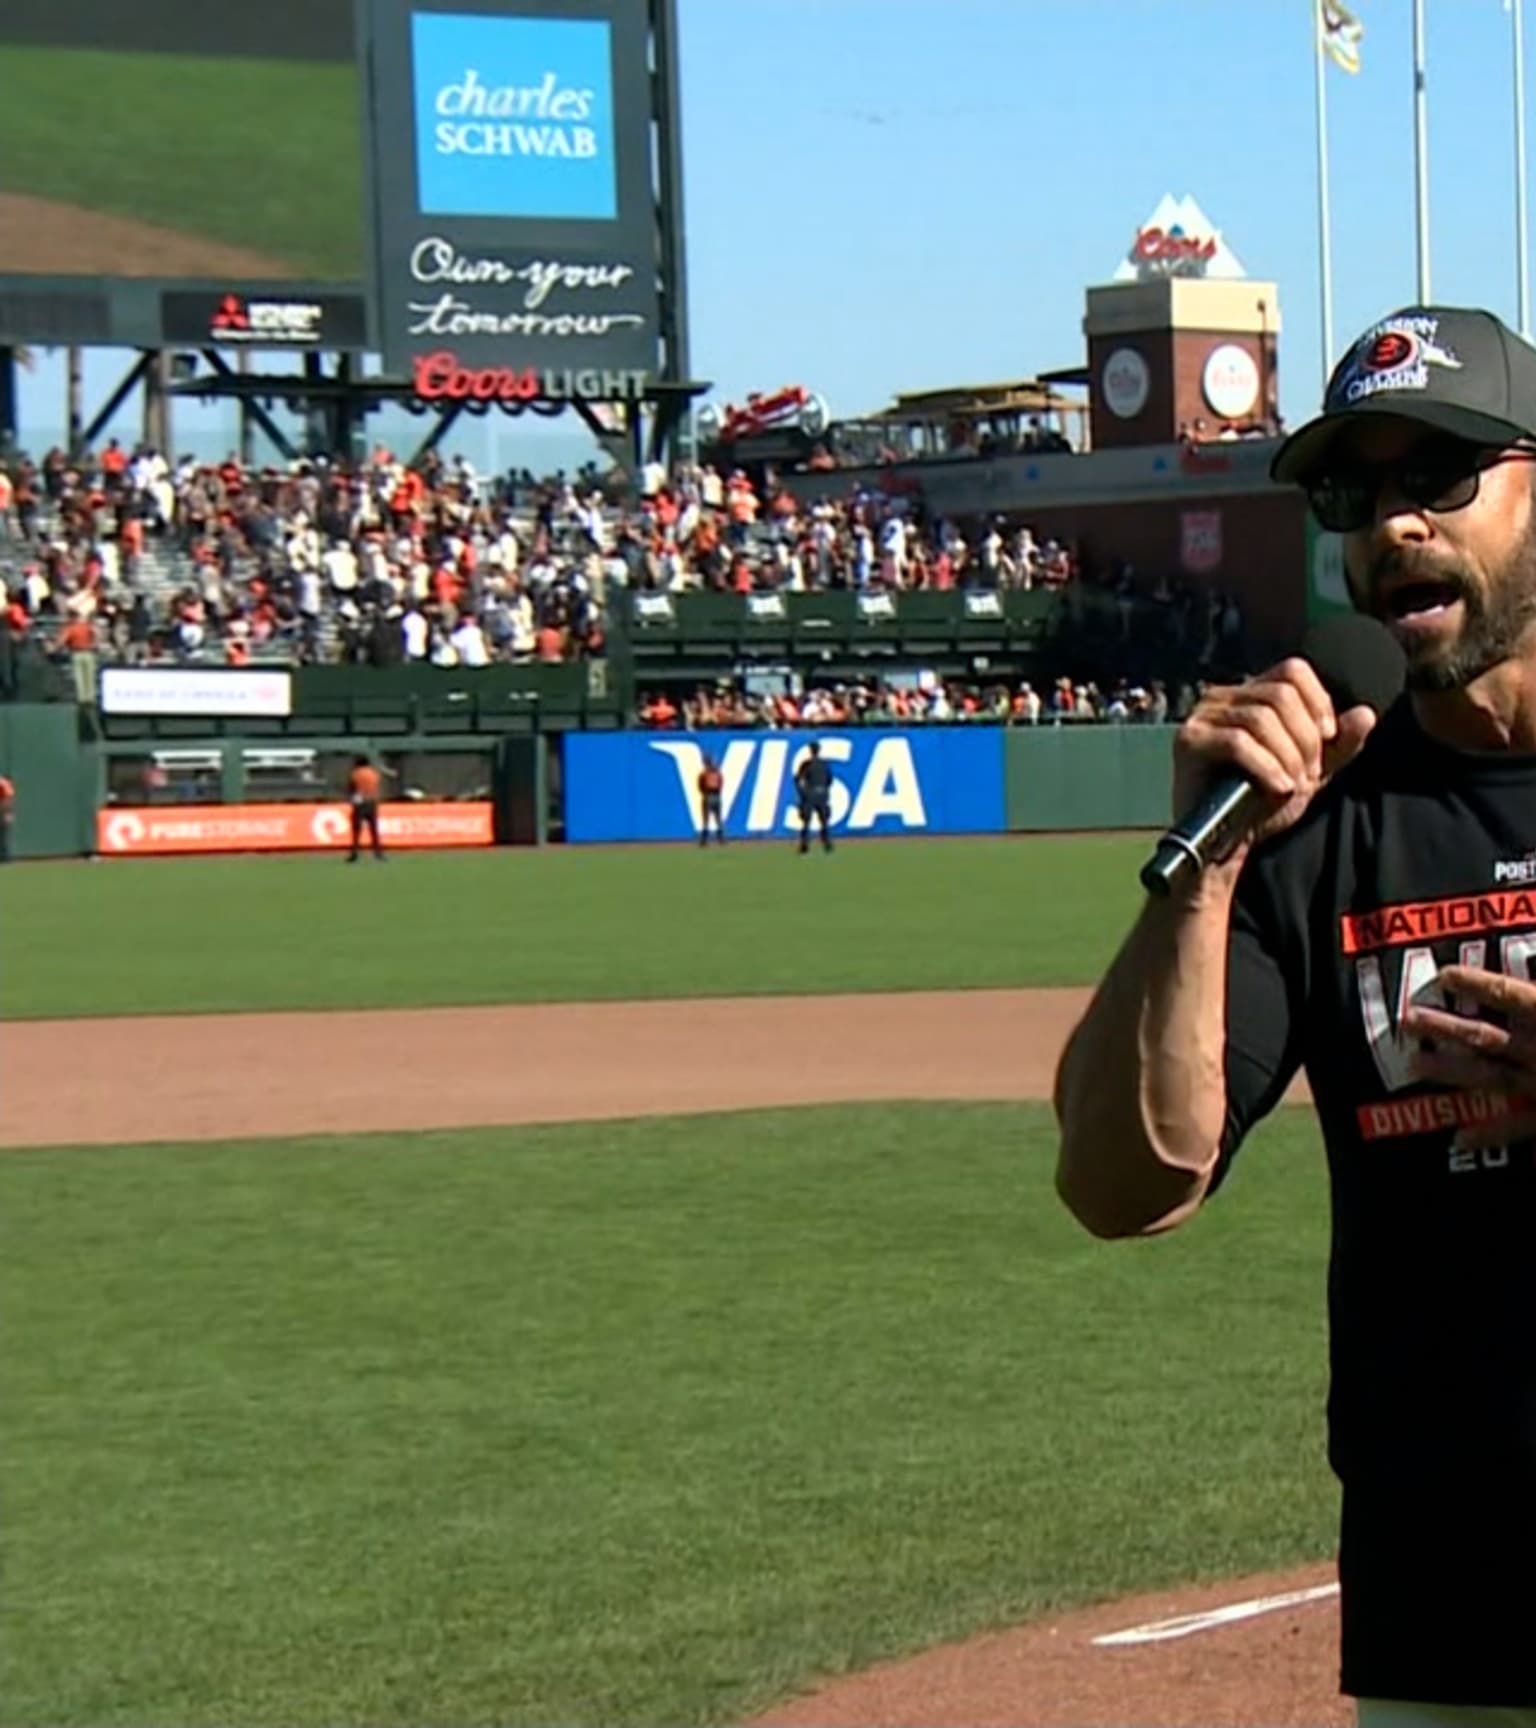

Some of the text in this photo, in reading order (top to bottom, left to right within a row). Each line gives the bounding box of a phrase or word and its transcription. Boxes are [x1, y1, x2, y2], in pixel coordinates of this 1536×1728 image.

[435, 69, 594, 120] charles
[435, 122, 597, 159] SCHWAB
[409, 238, 634, 308] Own your
[407, 294, 645, 334] tomorrow
[412, 350, 649, 398] Coors LIGHT
[648, 737, 928, 831] VISA
[1371, 1093, 1511, 1134] DIVISION
